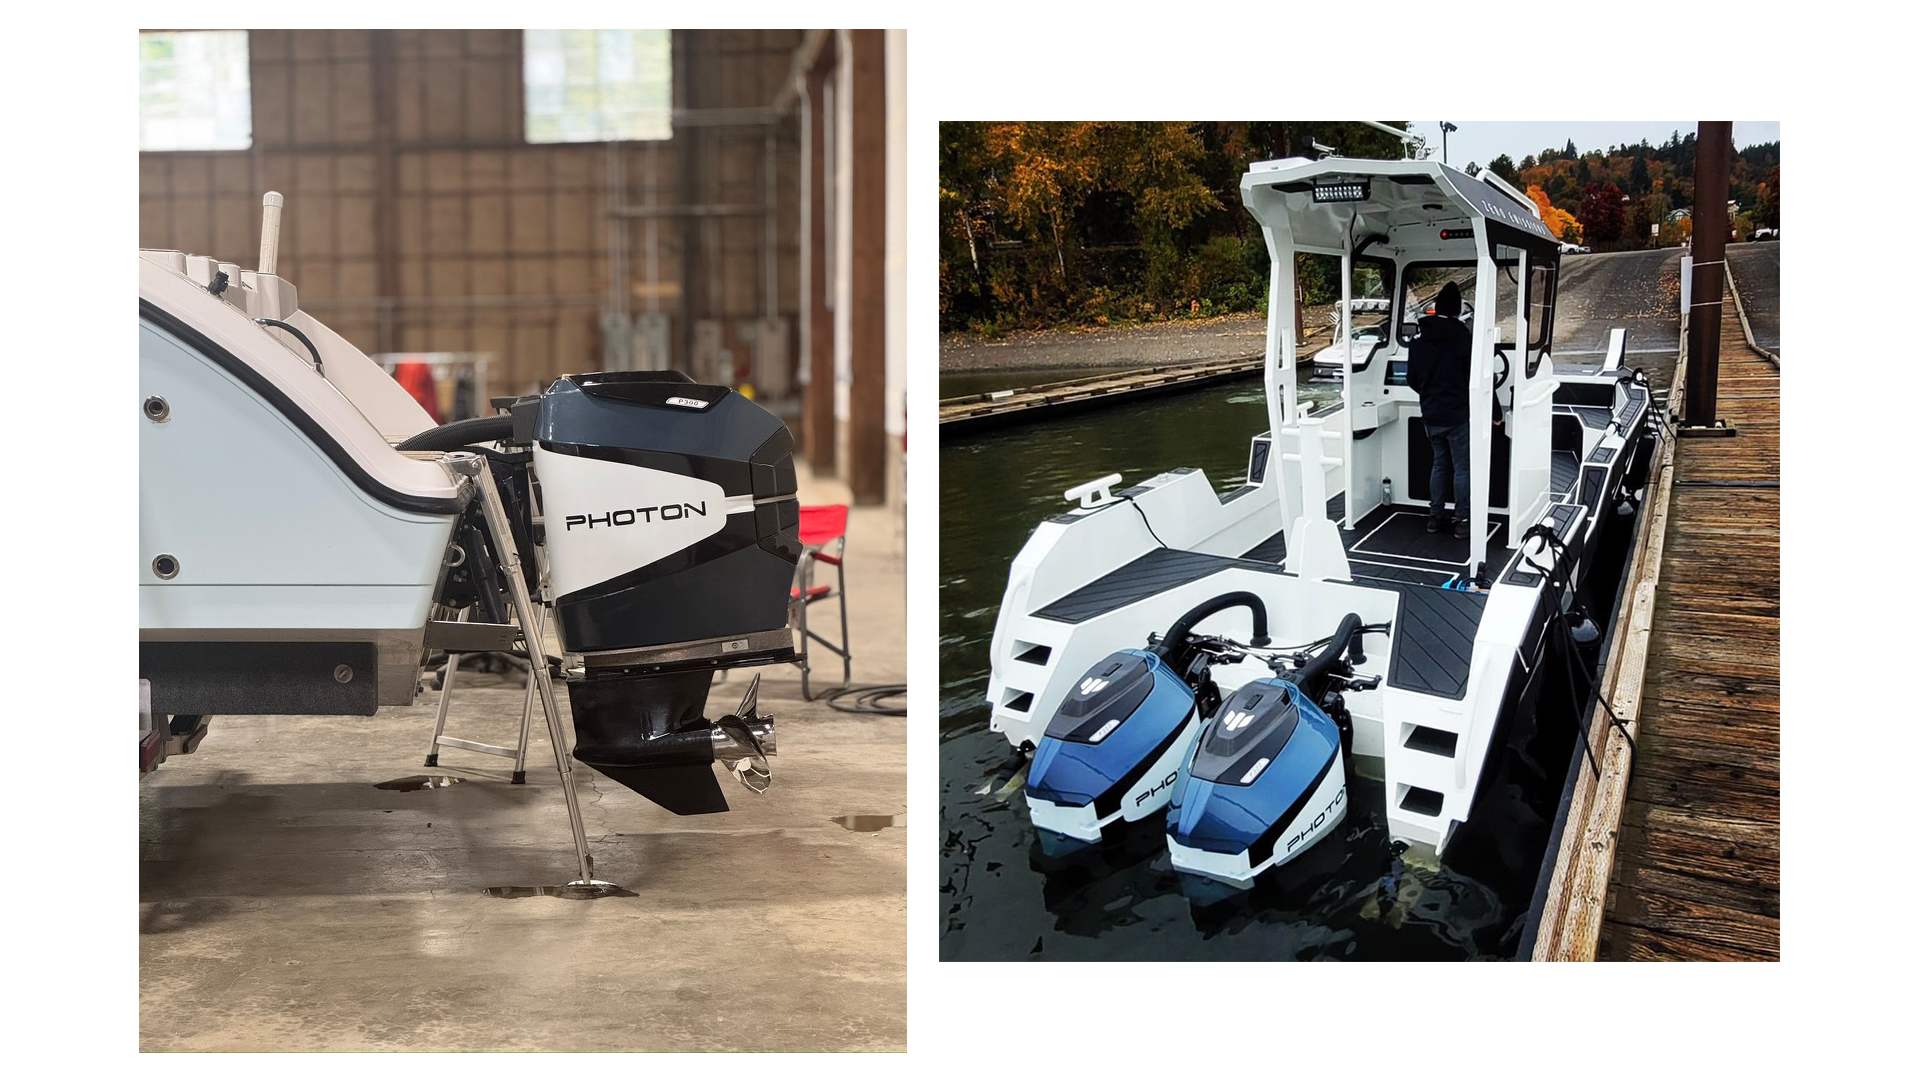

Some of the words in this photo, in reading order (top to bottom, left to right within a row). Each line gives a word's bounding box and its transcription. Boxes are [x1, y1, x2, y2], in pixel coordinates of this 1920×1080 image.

[678, 398, 699, 406] P300
[565, 501, 707, 531] PHOTON
[1135, 767, 1180, 807] PHO
[1287, 783, 1346, 852] PHOTO
